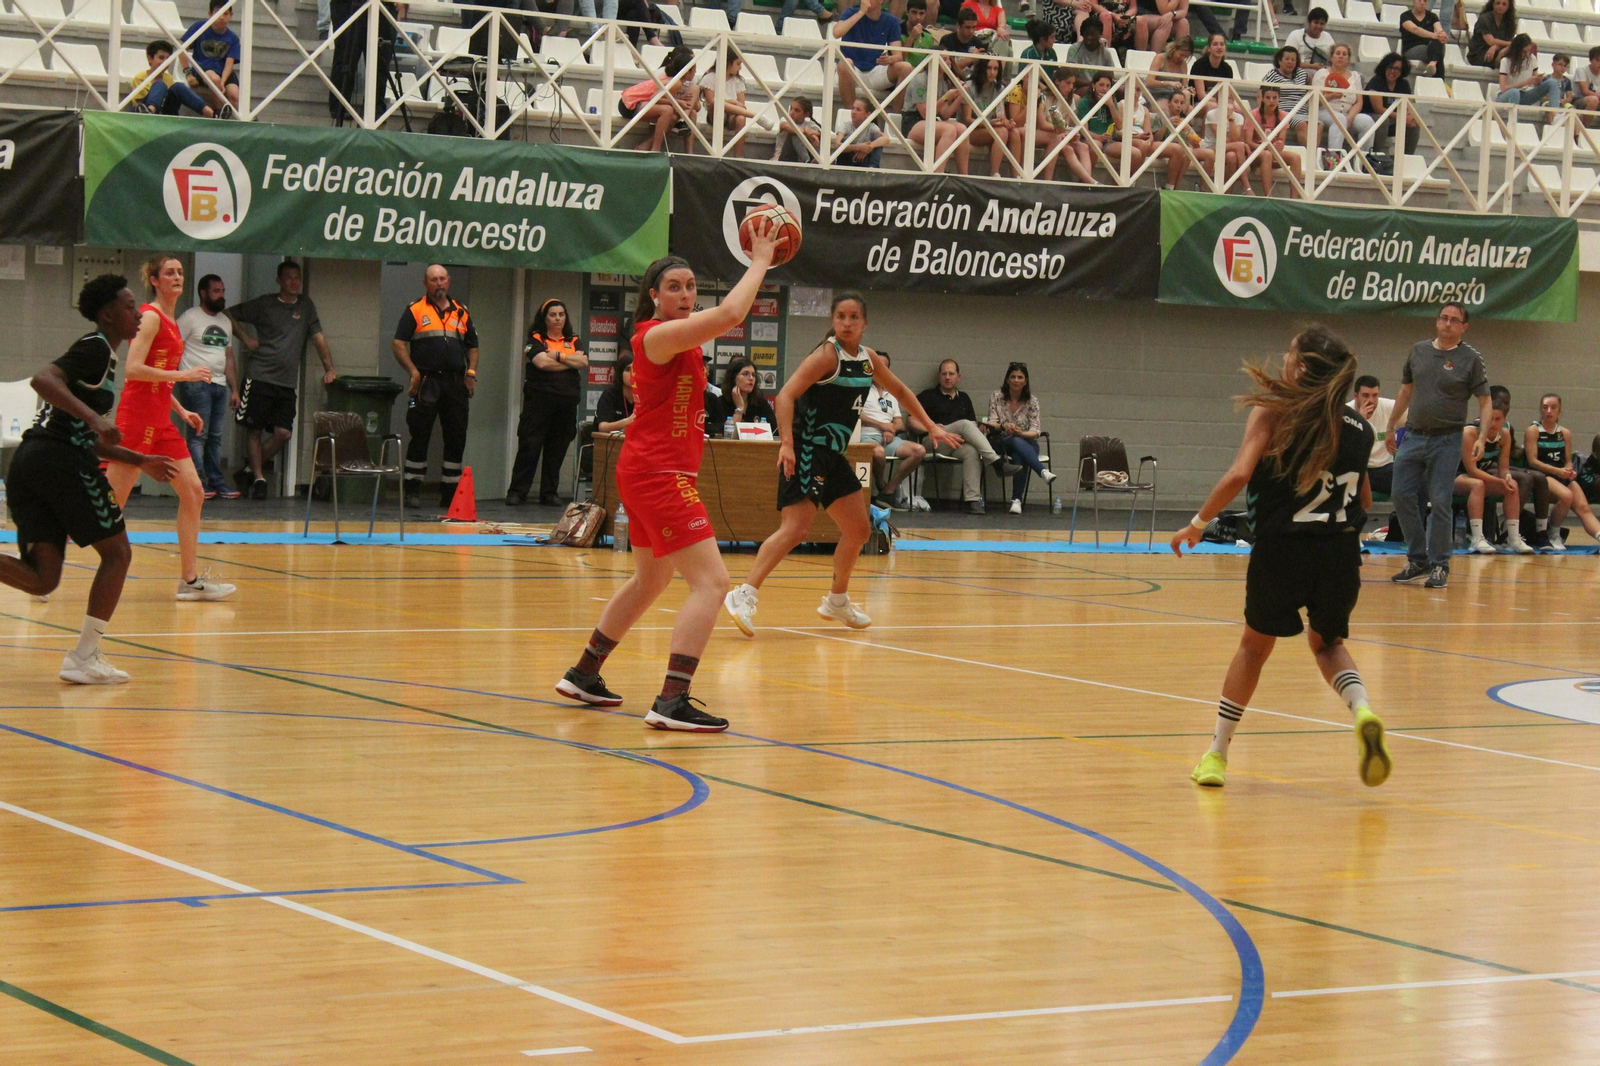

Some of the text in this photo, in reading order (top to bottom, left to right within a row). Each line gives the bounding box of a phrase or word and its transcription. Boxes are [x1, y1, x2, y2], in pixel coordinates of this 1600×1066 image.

[262, 153, 605, 211] Federación Andaluza
[323, 205, 547, 253] de Baloncesto
[812, 188, 1117, 238] Federación Andaluza
[865, 238, 1066, 280] de Baloncesto
[1283, 225, 1532, 269] Federación Andaluza
[1326, 269, 1486, 306] de Baloncesto
[671, 374, 693, 438] MARISTAS
[1343, 415, 1364, 432] ONA
[859, 466, 868, 482] 2
